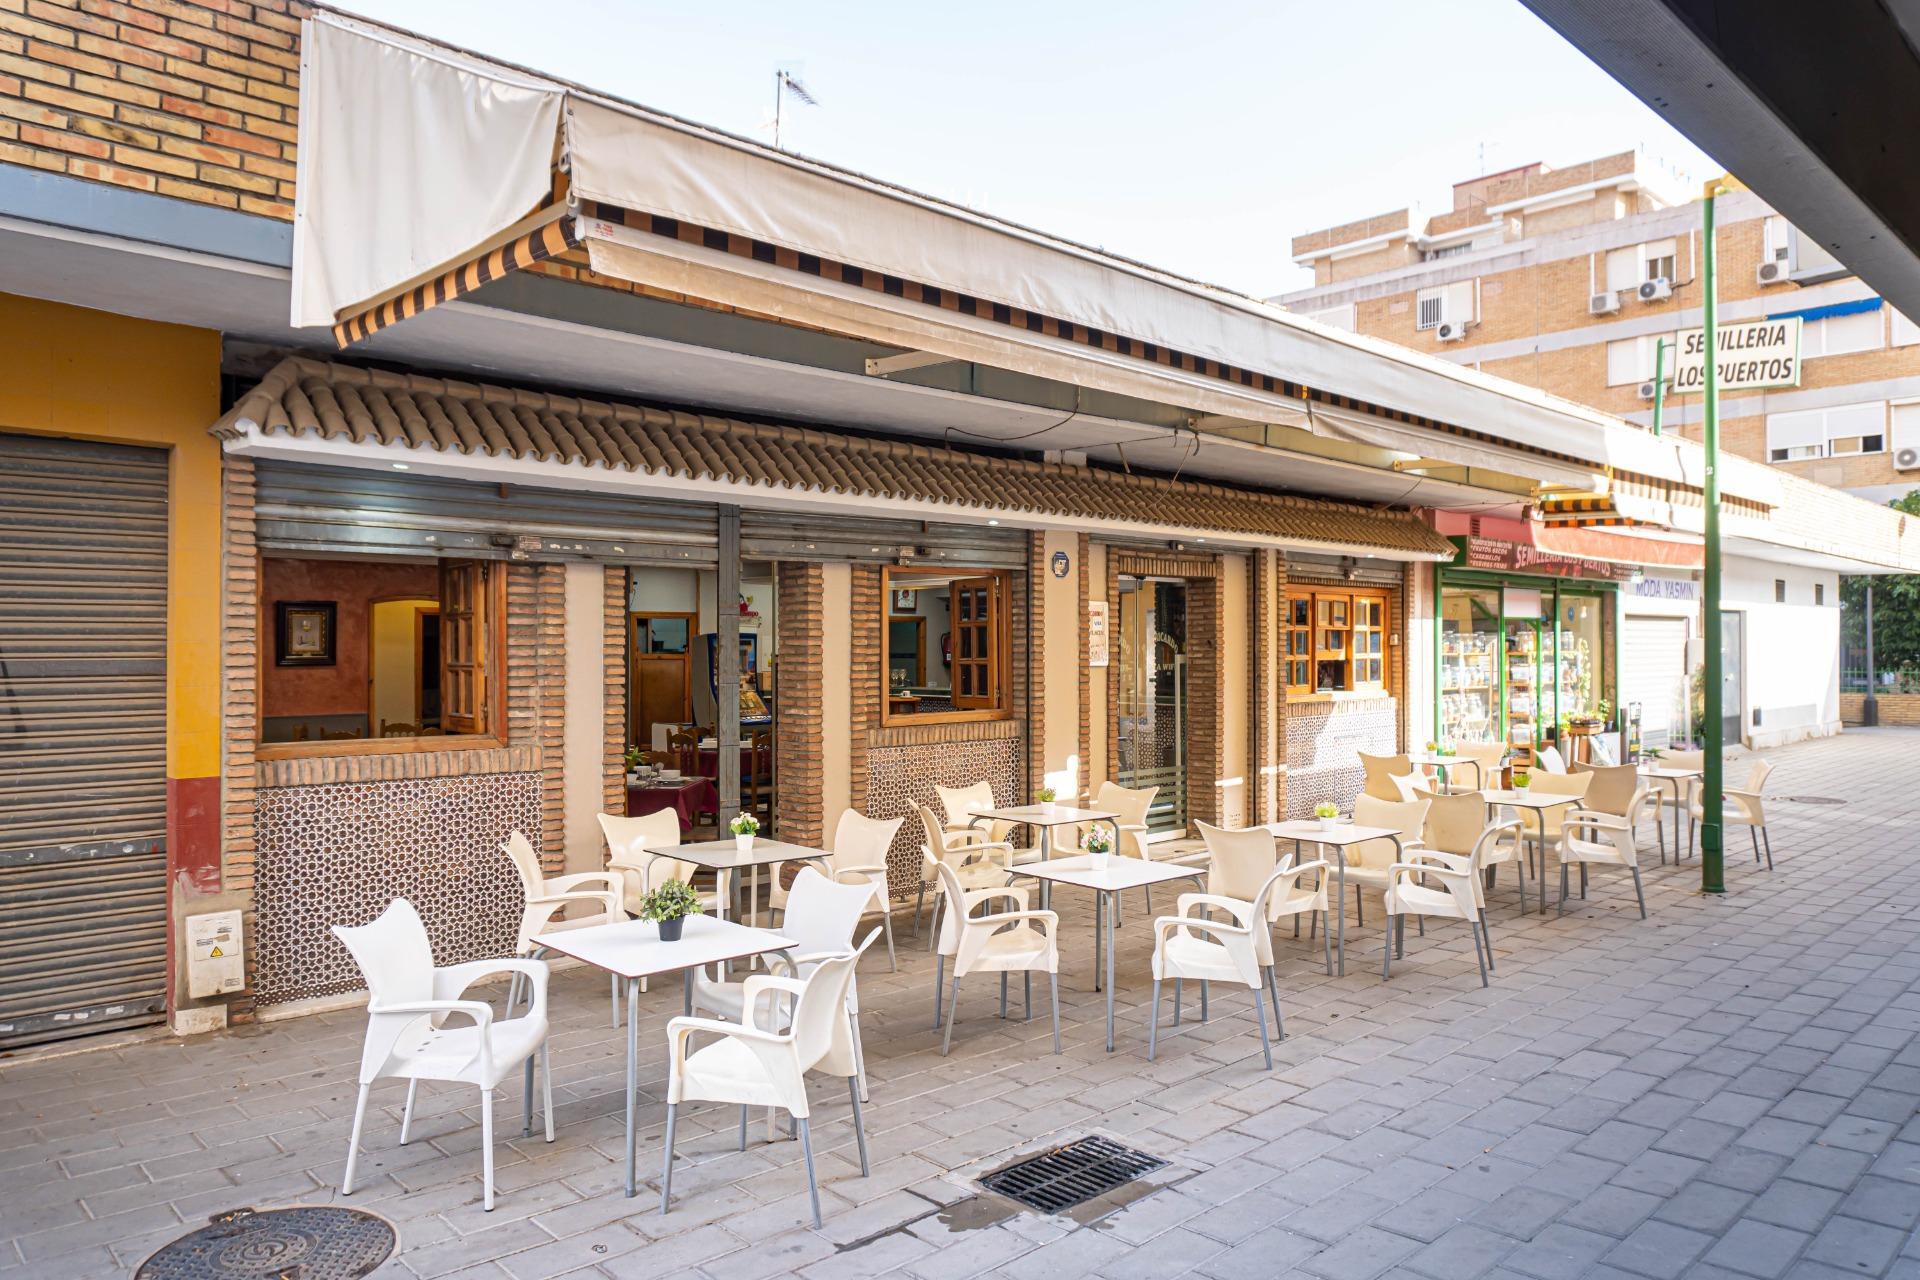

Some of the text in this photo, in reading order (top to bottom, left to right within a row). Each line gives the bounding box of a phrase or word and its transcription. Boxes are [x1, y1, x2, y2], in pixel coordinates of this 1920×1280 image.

[1684, 324, 1786, 355] SEILLERIA
[1636, 579, 1694, 600] MODA YASMIN
